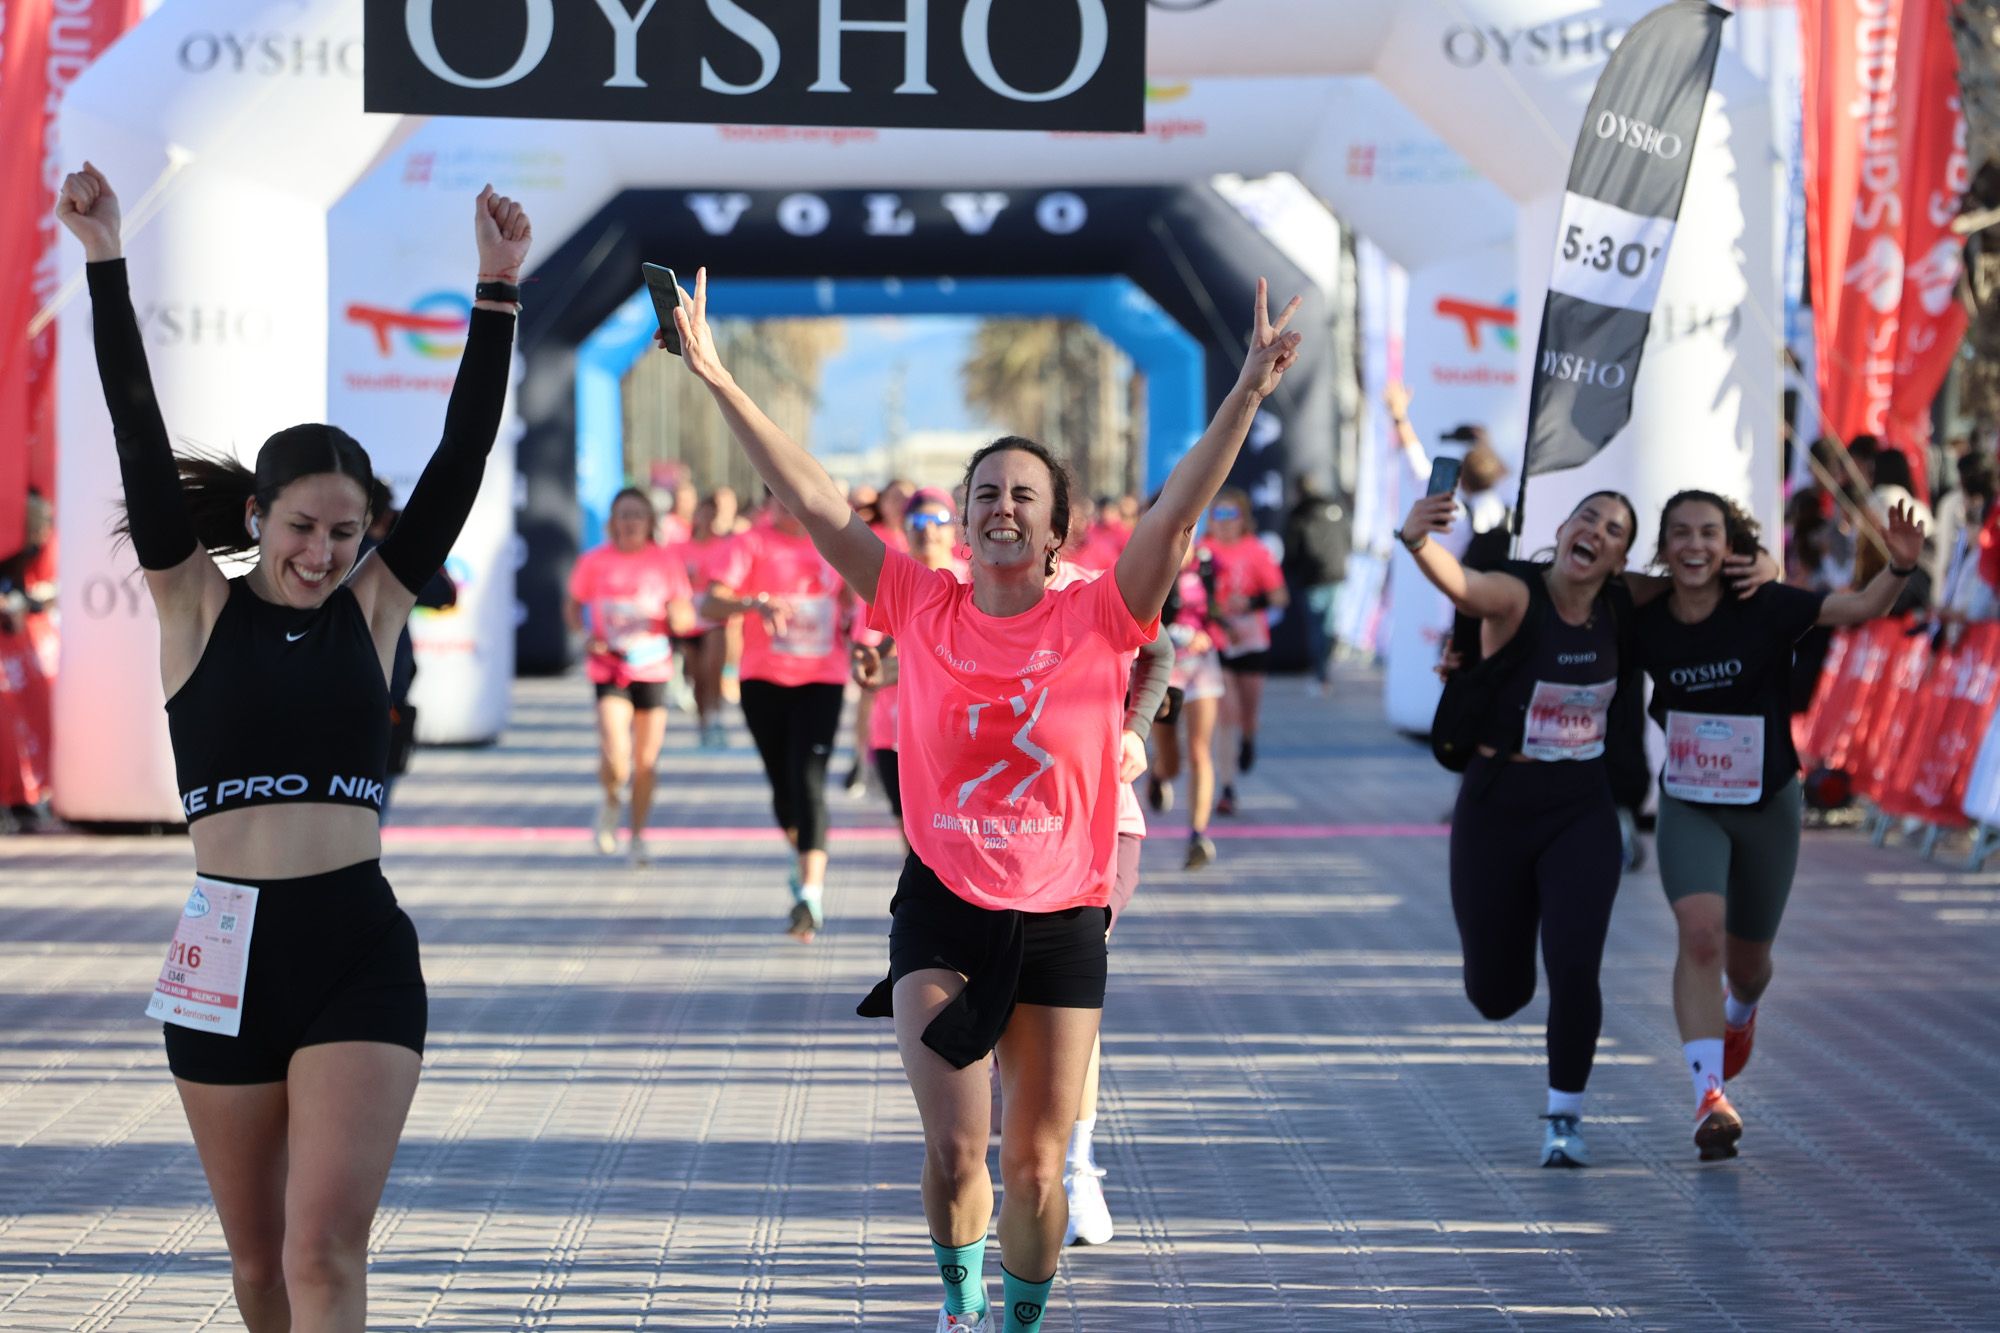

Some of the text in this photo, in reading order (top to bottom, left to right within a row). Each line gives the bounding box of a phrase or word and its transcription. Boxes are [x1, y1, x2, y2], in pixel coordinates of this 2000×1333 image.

[405, 0, 1108, 101] OYSHO
[1596, 109, 1682, 160] OYSHO
[684, 191, 1089, 237] VOLVO
[1557, 652, 1597, 664] OYSHO
[1669, 658, 1742, 686] OYSHO
[1696, 753, 1733, 770] 016
[216, 774, 309, 805] PRO
[328, 775, 384, 806] NIK
[983, 819, 998, 834] DE
[1002, 819, 1017, 834] LA
[1020, 816, 1063, 834] MUJER
[182, 1007, 222, 1024] Santander
